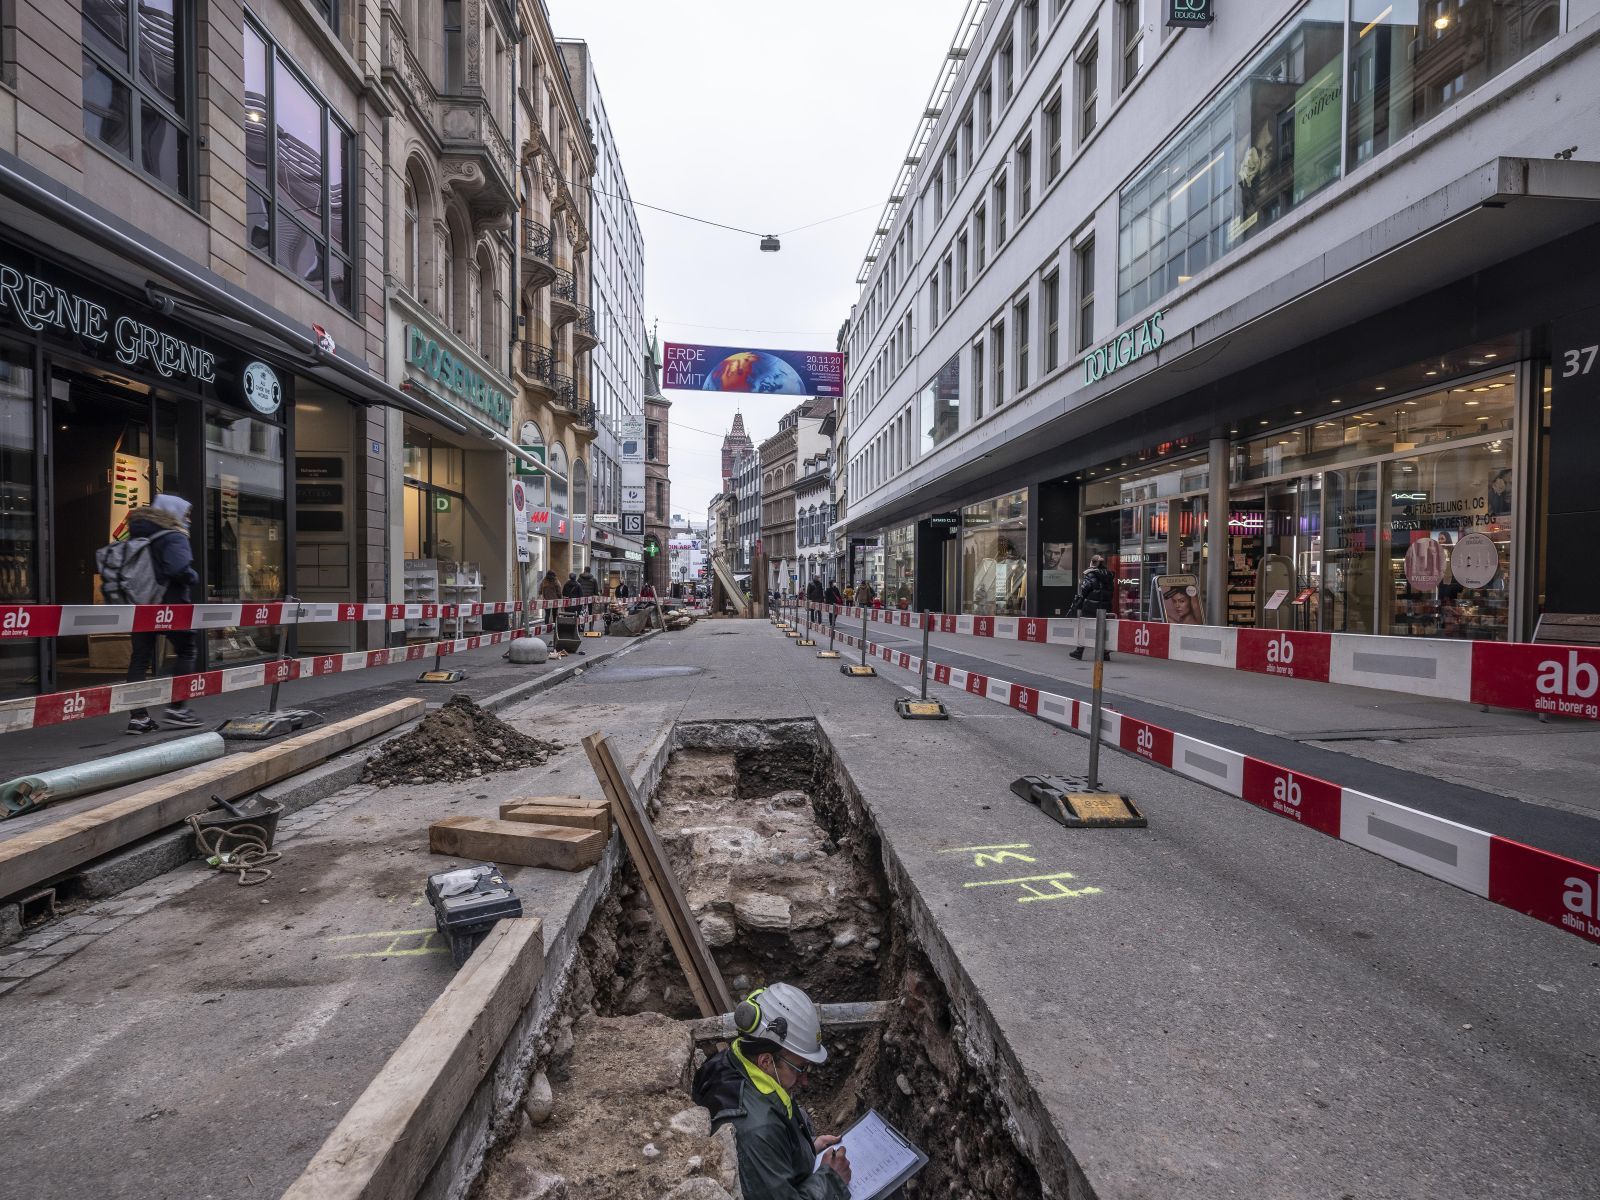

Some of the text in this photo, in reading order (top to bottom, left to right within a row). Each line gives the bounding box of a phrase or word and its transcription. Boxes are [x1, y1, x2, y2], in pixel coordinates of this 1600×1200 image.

[1174, 11, 1205, 20] DOUGLAS
[114, 316, 215, 383] GRENE
[667, 347, 705, 361] ERDE
[1084, 311, 1165, 385] DOUGLAS
[667, 360, 692, 372] AM
[806, 355, 840, 365] 20.11.20
[1562, 345, 1599, 378] 37
[407, 324, 513, 429] DOSENBACH
[667, 373, 704, 386] LIMIT
[521, 452, 541, 473] D
[436, 498, 449, 510] D
[1472, 497, 1484, 509] OG
[1485, 512, 1497, 525] OG
[3, 607, 31, 629] ab
[155, 606, 174, 623] ab
[255, 604, 269, 620] ab
[979, 617, 987, 631] ab
[1027, 620, 1037, 635] ab
[1134, 623, 1150, 647] ab
[1266, 632, 1294, 664] ab
[277, 662, 289, 676] ab
[323, 656, 333, 669] ab
[1535, 650, 1599, 698] ab
[190, 675, 206, 692] ab
[63, 692, 86, 713] ab
[1019, 688, 1028, 704] ab
[1535, 696, 1598, 718] albin borer ag
[1137, 725, 1153, 749] ab
[1273, 772, 1302, 806] ab
[1562, 873, 1600, 920] a
[1562, 912, 1585, 931] albin
